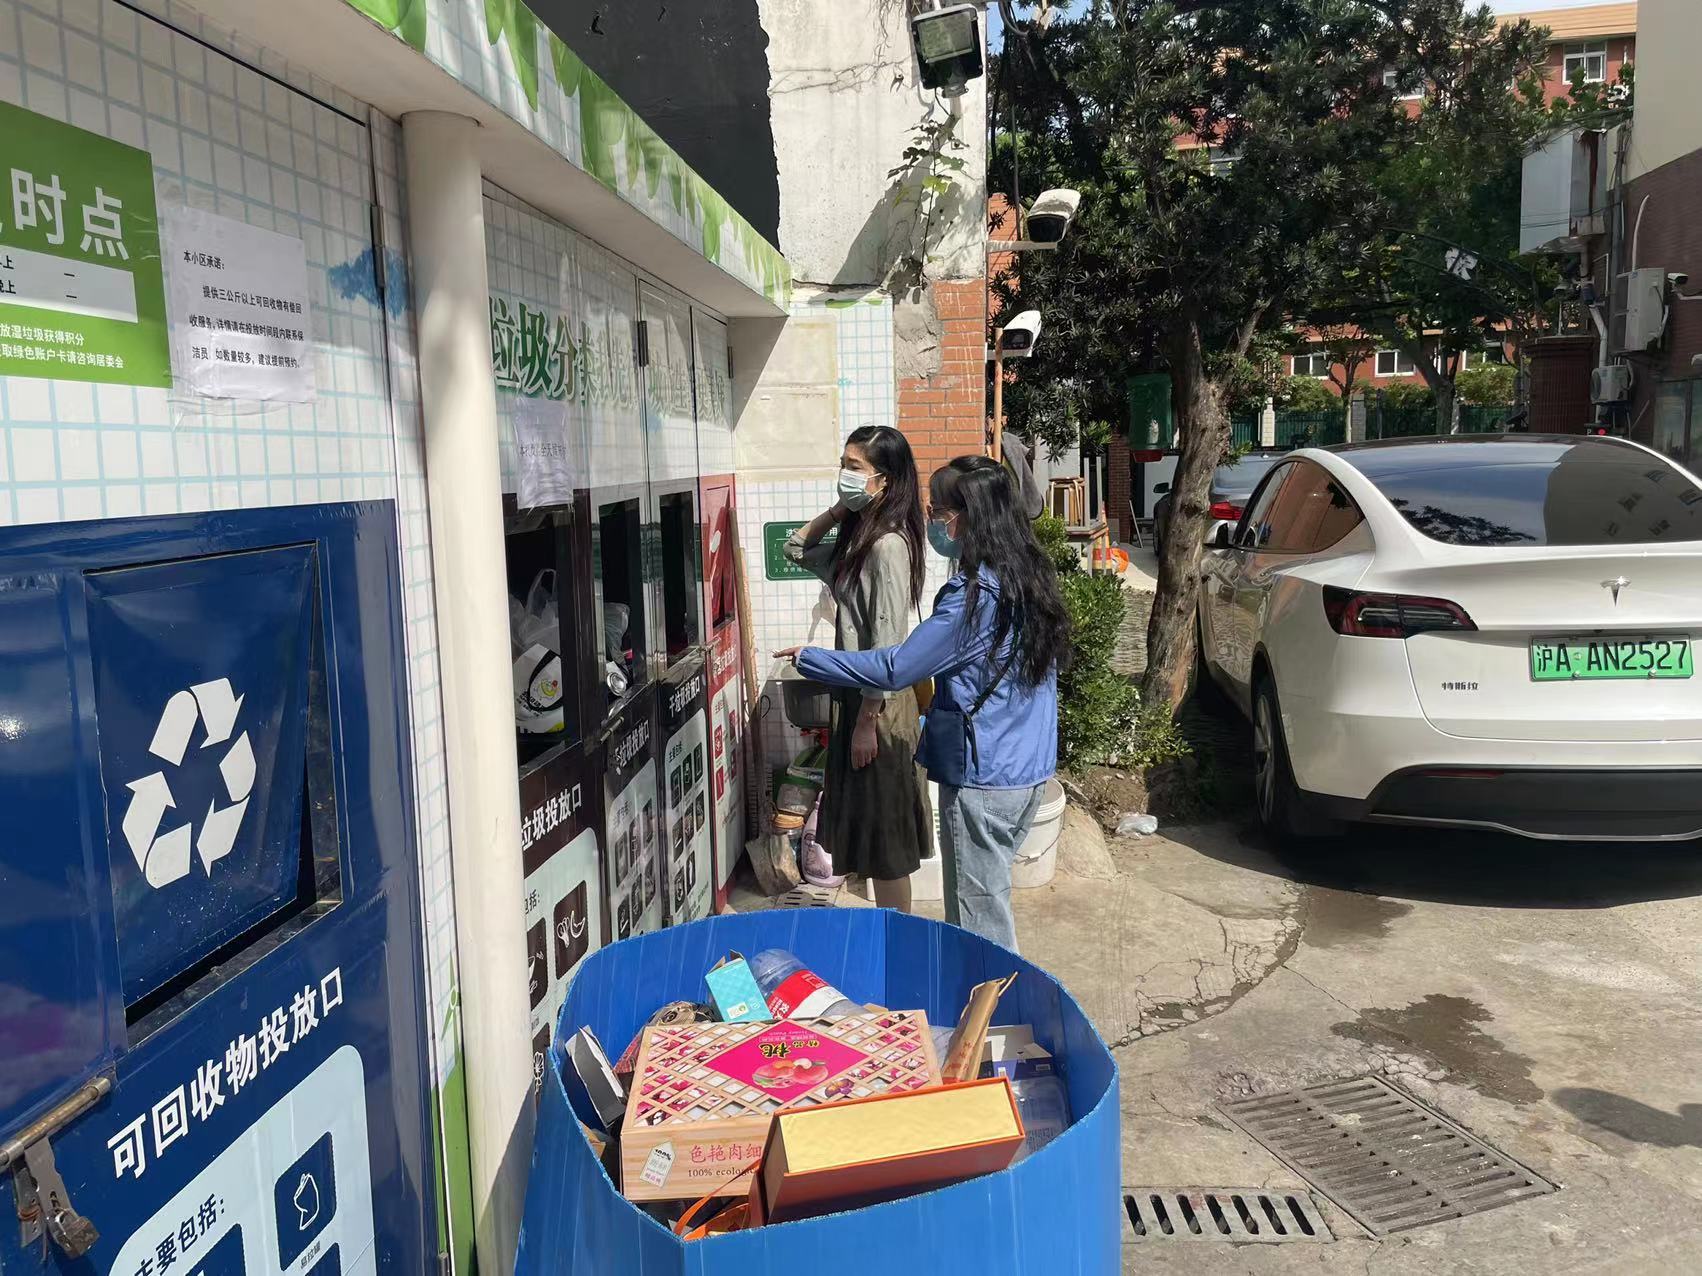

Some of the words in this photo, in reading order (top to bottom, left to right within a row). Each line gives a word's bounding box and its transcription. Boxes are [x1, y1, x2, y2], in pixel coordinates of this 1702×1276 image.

[0, 168, 129, 260] 时点
[0, 343, 124, 368] 取绿色账户卡请咨询居委会
[107, 966, 344, 1179] 可回收物投放口
[688, 1168, 713, 1177] 100%
